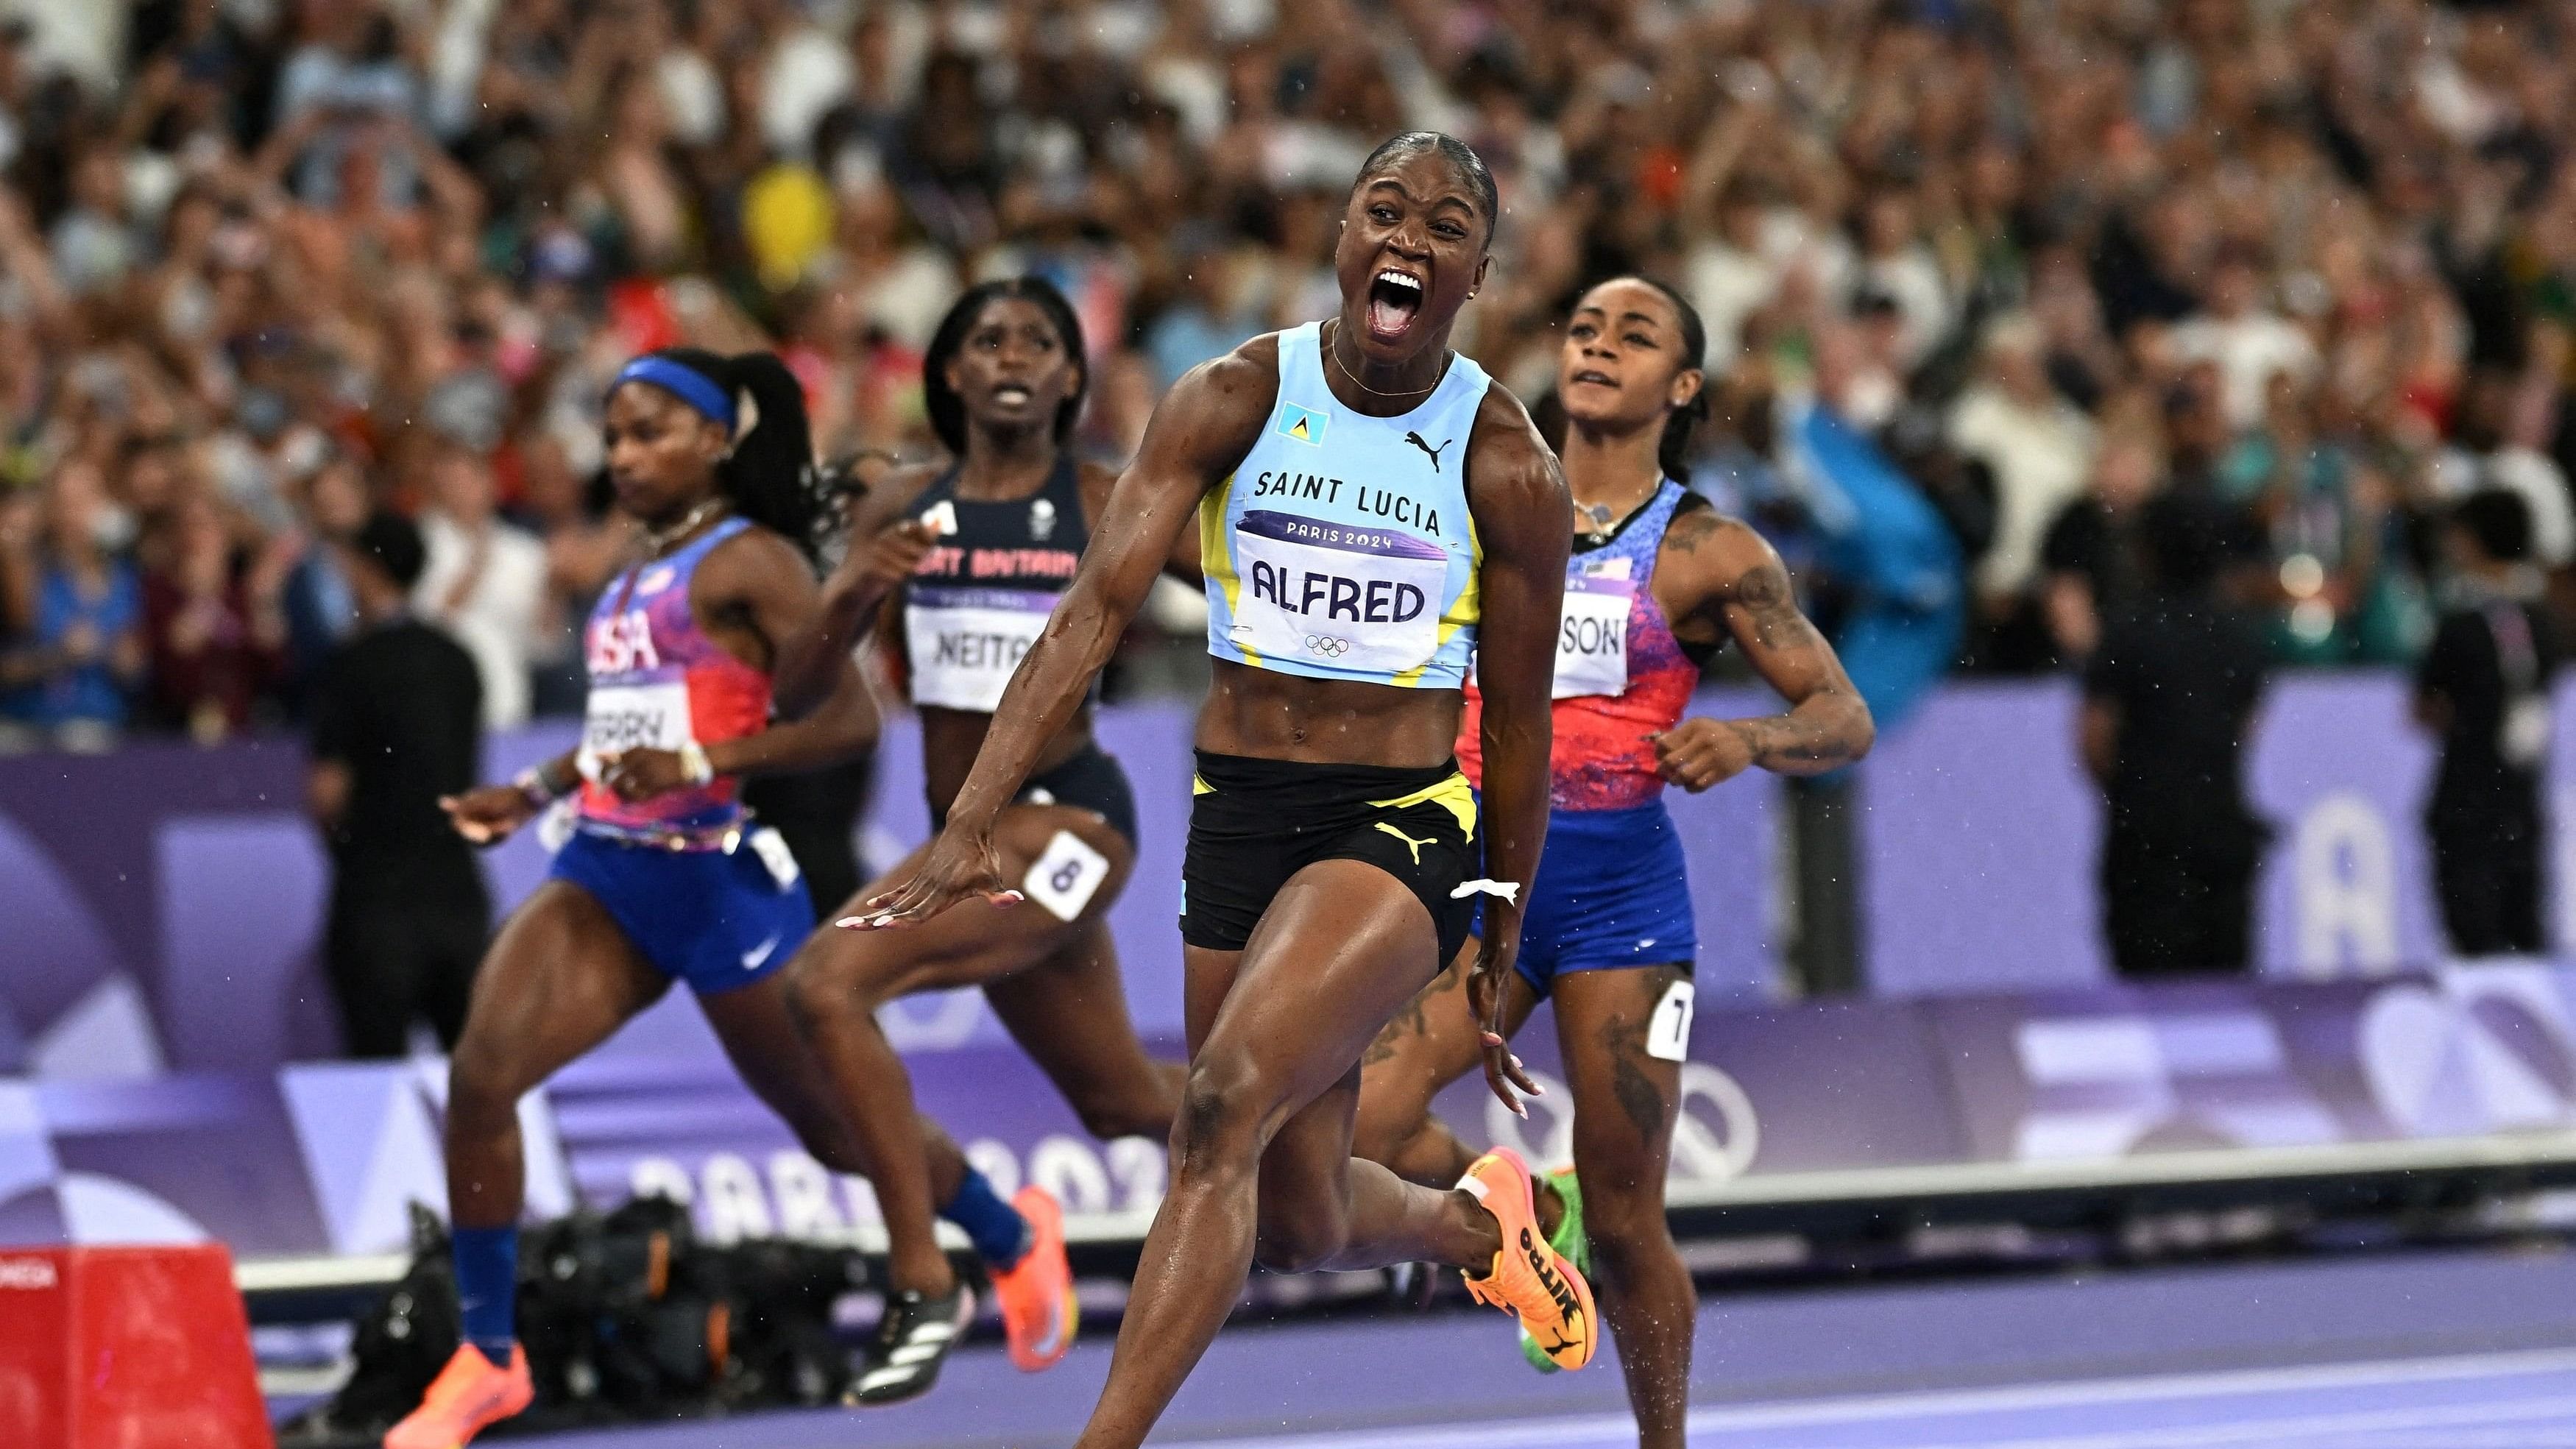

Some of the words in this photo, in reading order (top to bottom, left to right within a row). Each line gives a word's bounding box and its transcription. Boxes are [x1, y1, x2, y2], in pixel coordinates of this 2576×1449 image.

[1254, 471, 1343, 503] SAINT
[1357, 486, 1440, 537] LUCIA
[1287, 522, 1340, 542] PARIS
[1345, 532, 1392, 549] 2024
[1251, 560, 1426, 623] ALFRED
[1051, 860, 1082, 894] 8
[1674, 999, 1685, 1043] 7
